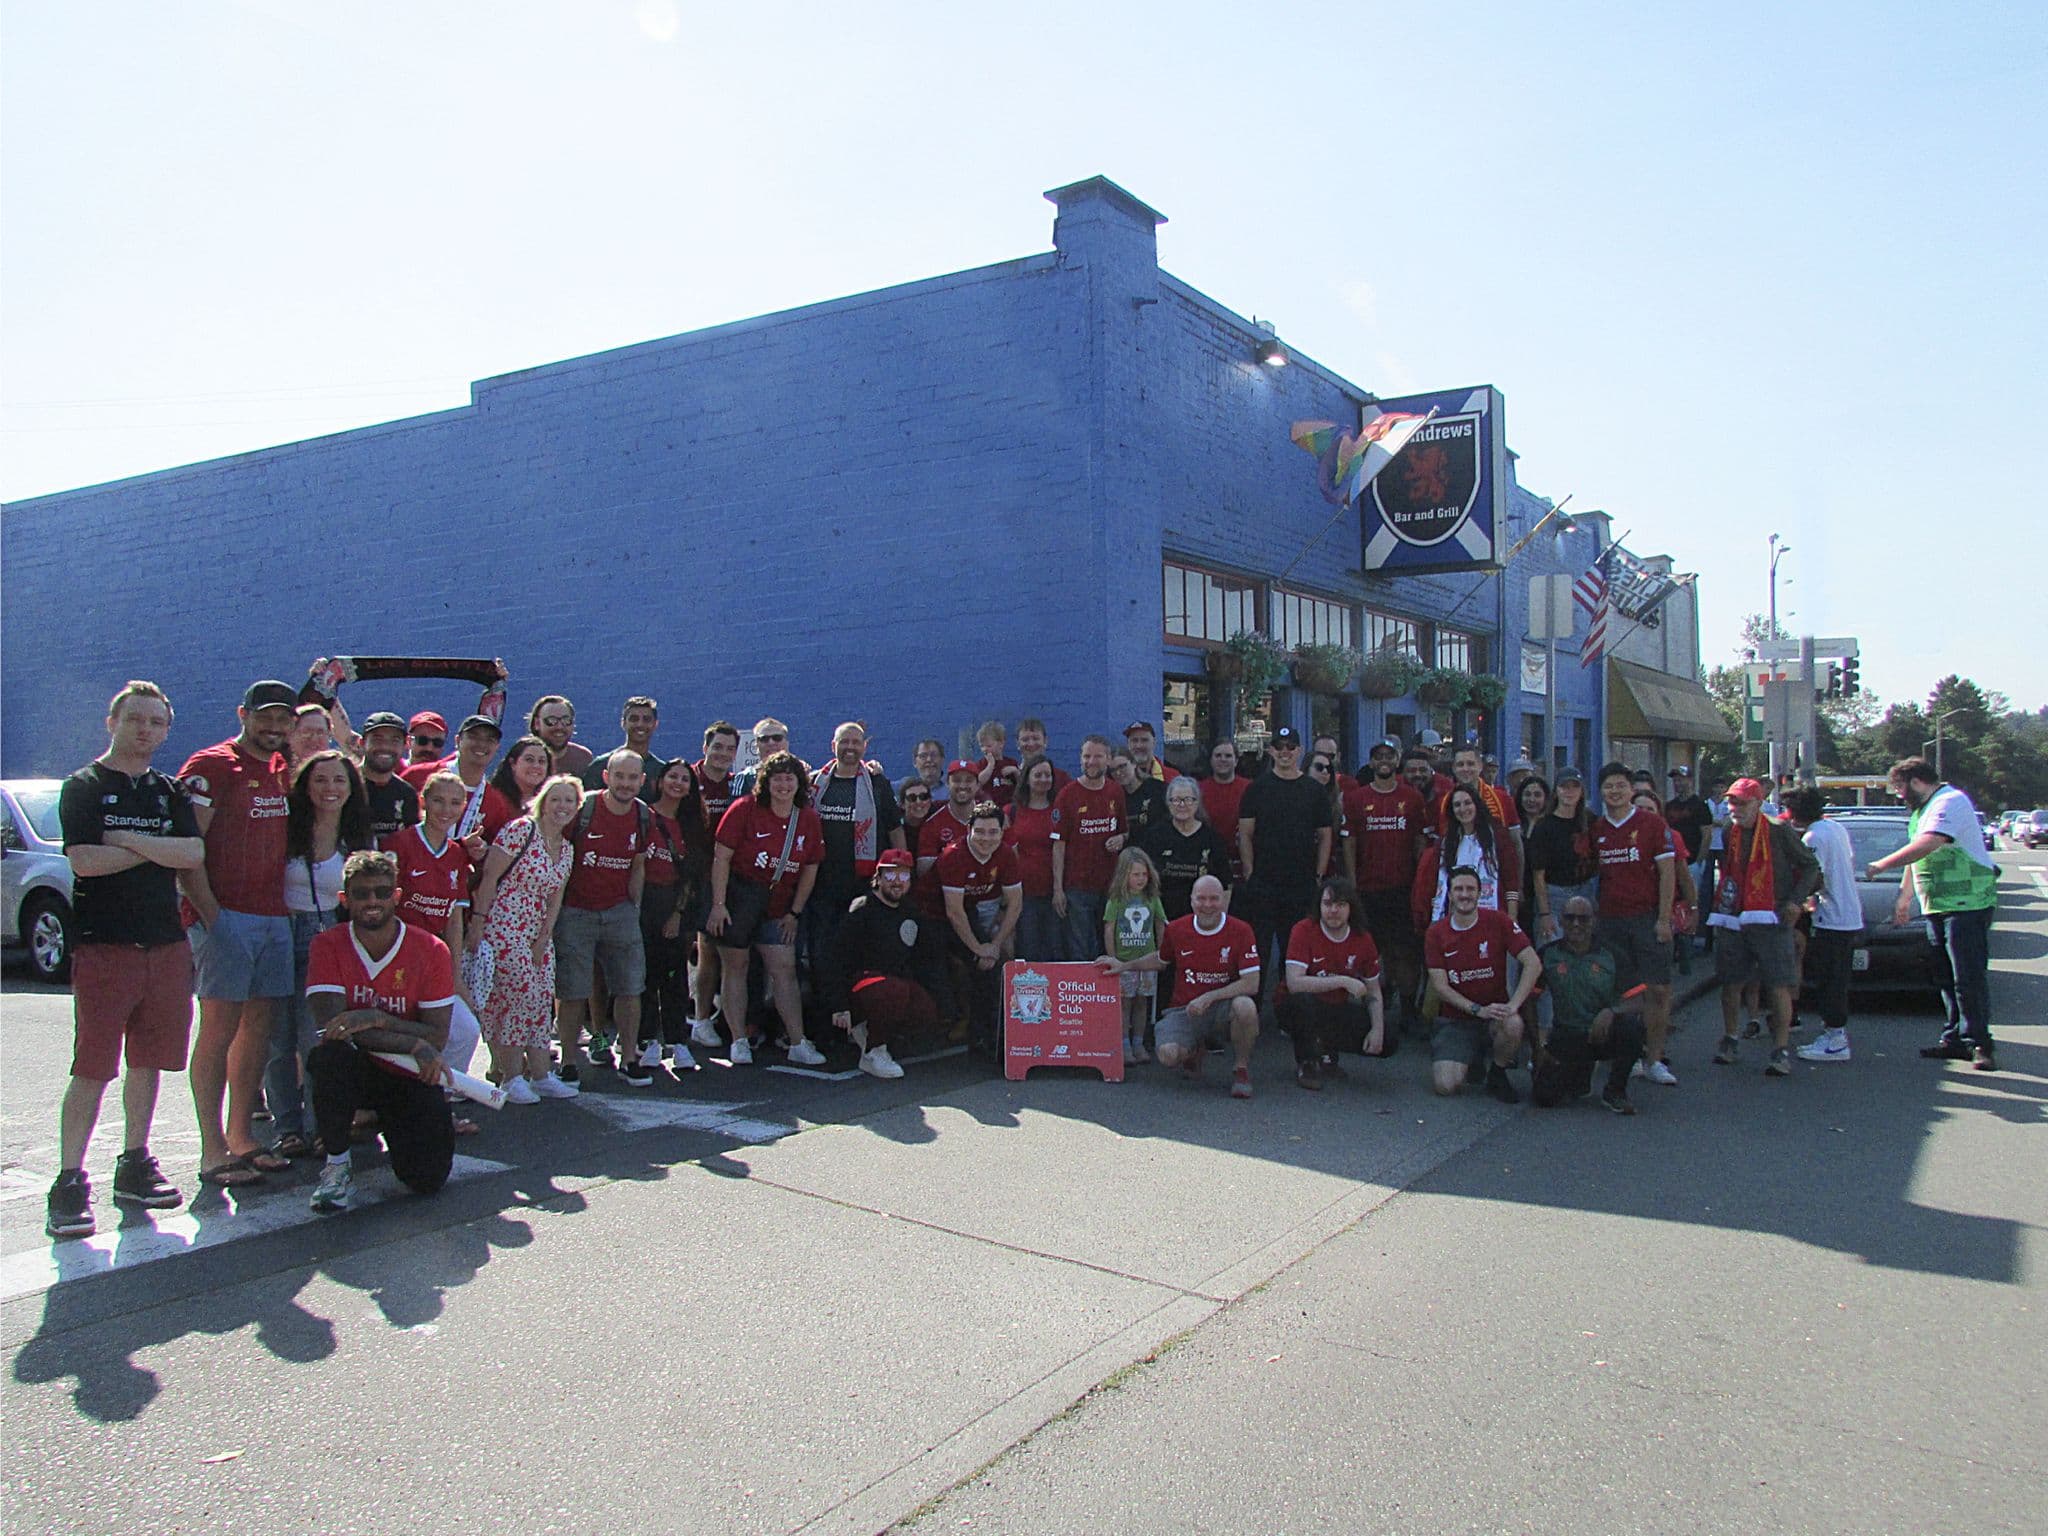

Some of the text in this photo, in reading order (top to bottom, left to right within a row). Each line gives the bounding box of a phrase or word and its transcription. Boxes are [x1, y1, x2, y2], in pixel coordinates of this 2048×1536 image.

[1394, 506, 1459, 523] Bar and Grill
[104, 815, 161, 828] Standard
[1081, 817, 1110, 826] Standard
[1080, 825, 1110, 834] Chartered
[1600, 848, 1628, 857] tandard
[411, 893, 449, 906] Standard
[404, 901, 446, 917] Chartered
[1058, 981, 1096, 992] Official
[1058, 992, 1117, 1004] Supporters
[1058, 1004, 1083, 1015] Club
